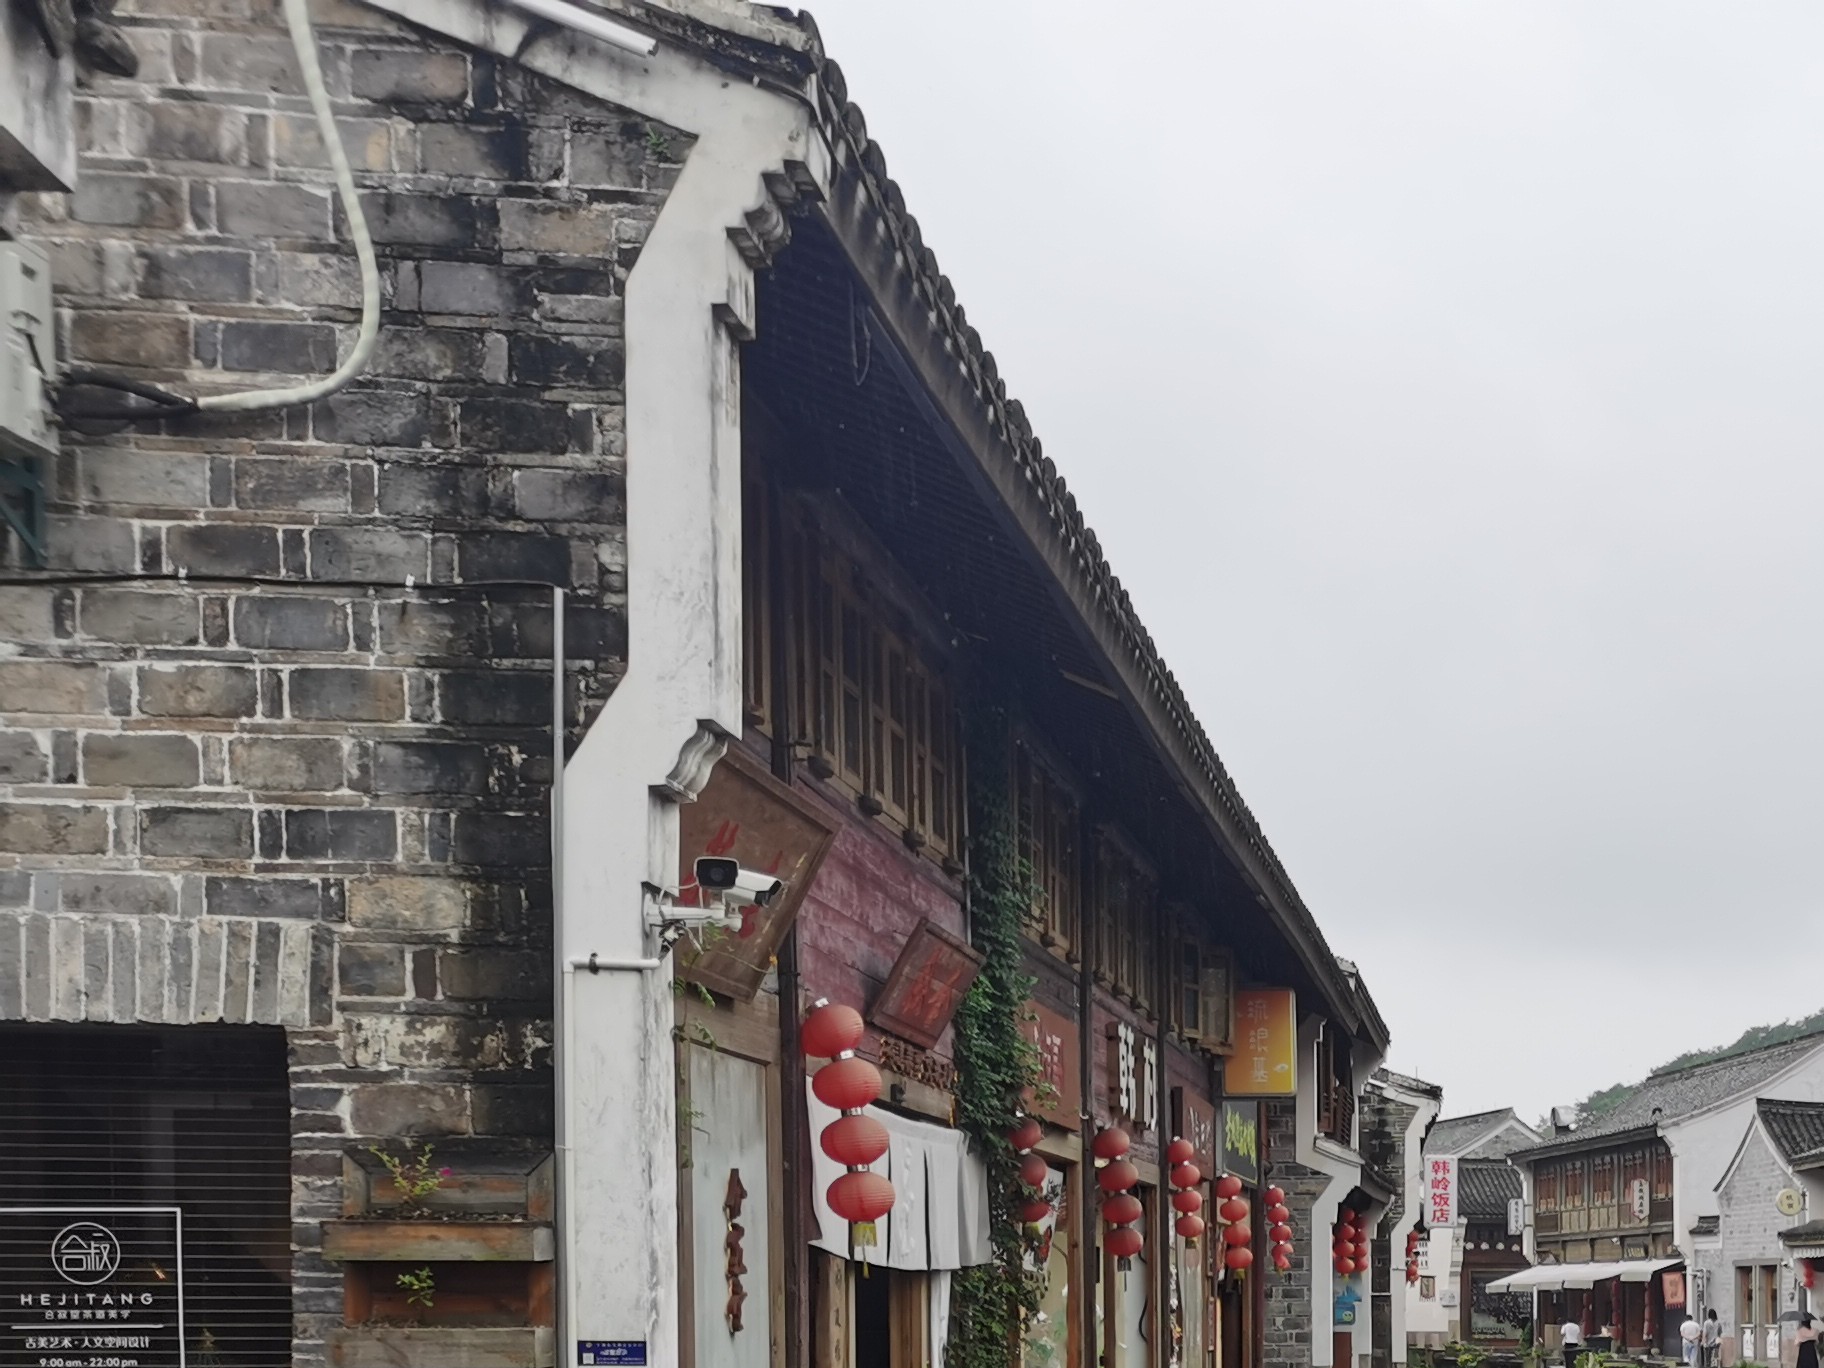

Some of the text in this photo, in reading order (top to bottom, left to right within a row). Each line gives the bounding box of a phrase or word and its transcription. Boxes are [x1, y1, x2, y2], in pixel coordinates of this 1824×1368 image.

[1431, 1160, 1451, 1223] 韩岭饭店
[20, 1293, 153, 1306] HEJITANG
